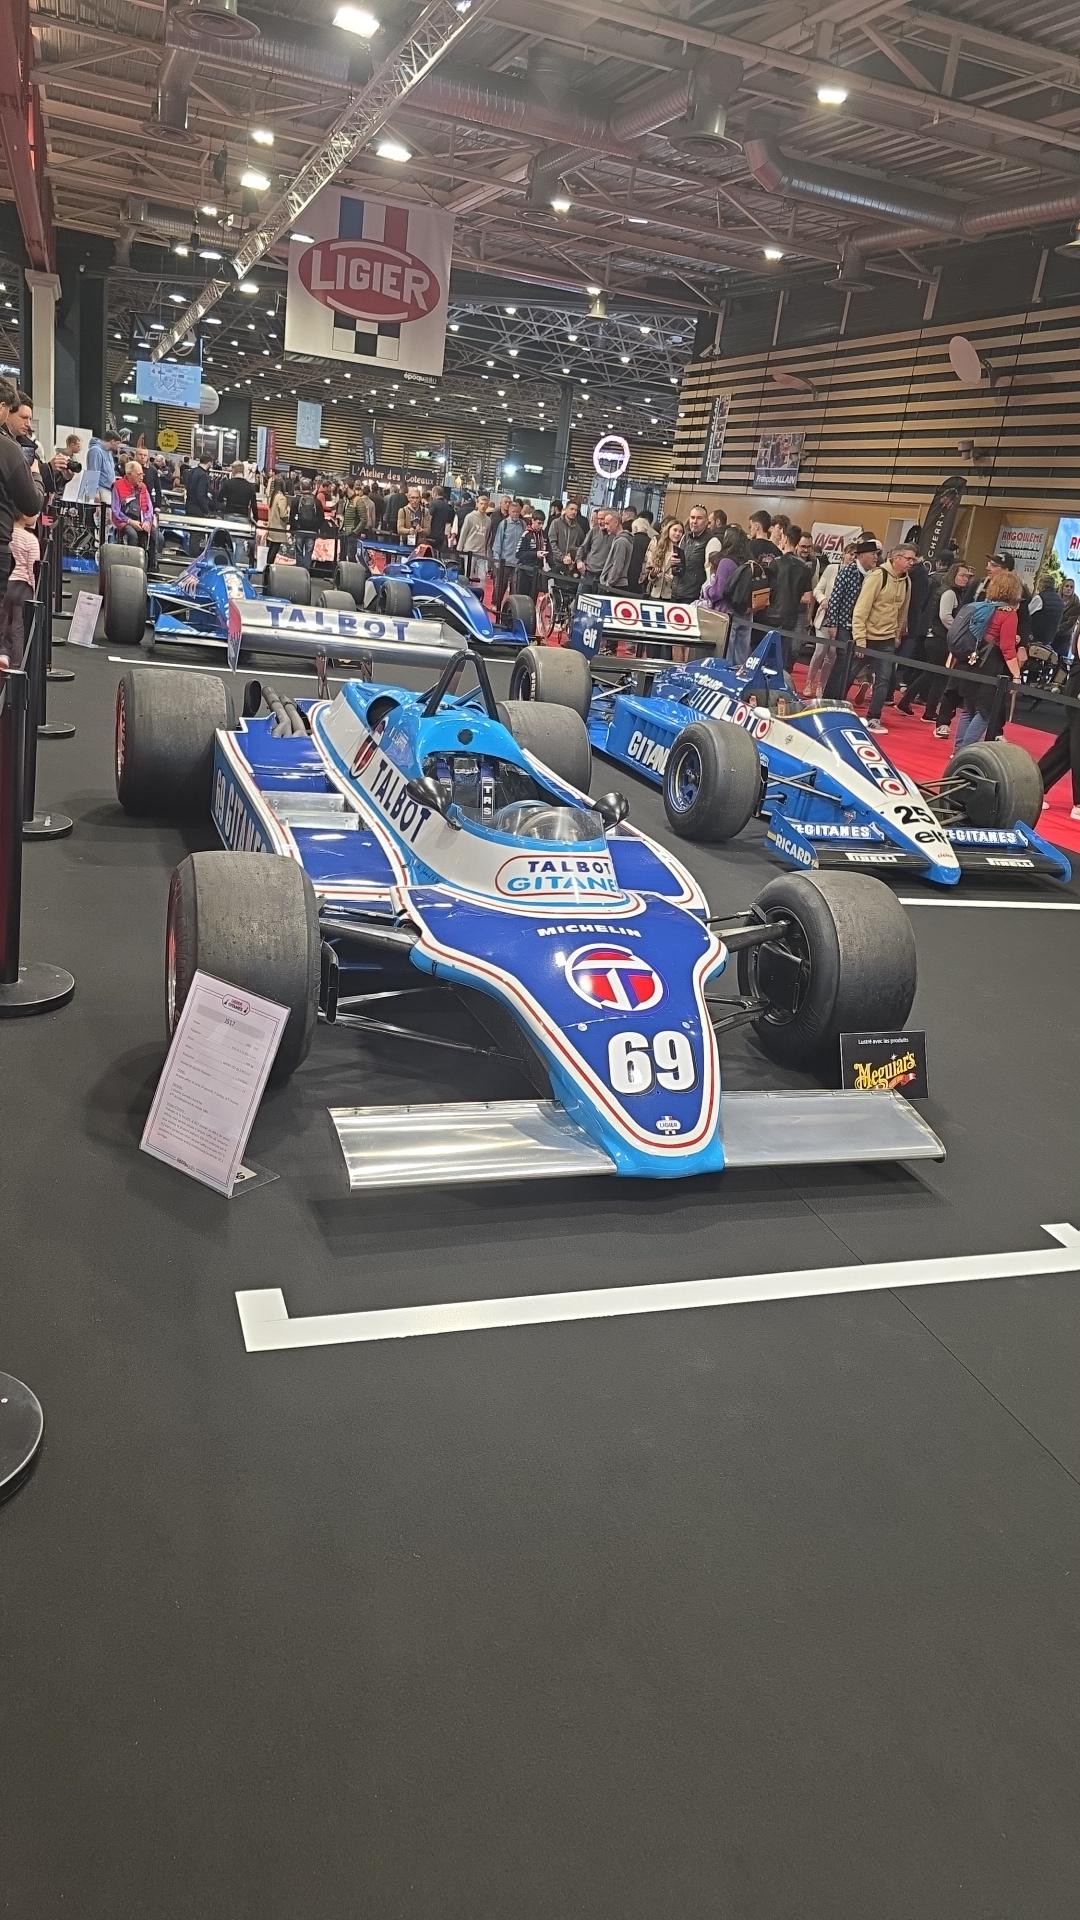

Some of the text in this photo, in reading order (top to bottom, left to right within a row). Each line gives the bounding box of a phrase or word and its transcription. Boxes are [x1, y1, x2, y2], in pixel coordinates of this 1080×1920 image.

[311, 250, 428, 311] LIGIER
[351, 464, 434, 485] L'Atelier des Coteaux
[927, 512, 945, 558] CHERRY
[577, 594, 602, 617] PIRELLI
[266, 606, 409, 641] TALBOT
[583, 628, 597, 649] elf
[745, 656, 760, 670] elf
[844, 730, 908, 796] LOTO
[215, 769, 226, 826] 69
[370, 759, 432, 843] TALBOT
[483, 785, 493, 815] TRS
[894, 805, 936, 825] 25
[804, 823, 870, 838] GITANES
[914, 830, 948, 845] elf
[956, 830, 1016, 844] GITANES
[775, 833, 812, 866] RICARD
[528, 860, 611, 875] TALBOT
[985, 857, 1035, 868] PIRELLI
[507, 876, 619, 893] GITANE
[537, 924, 642, 938] MICHELIN
[890, 1037, 909, 1045] produits
[608, 1031, 695, 1094] 69
[853, 1051, 917, 1090] Meguiar's
